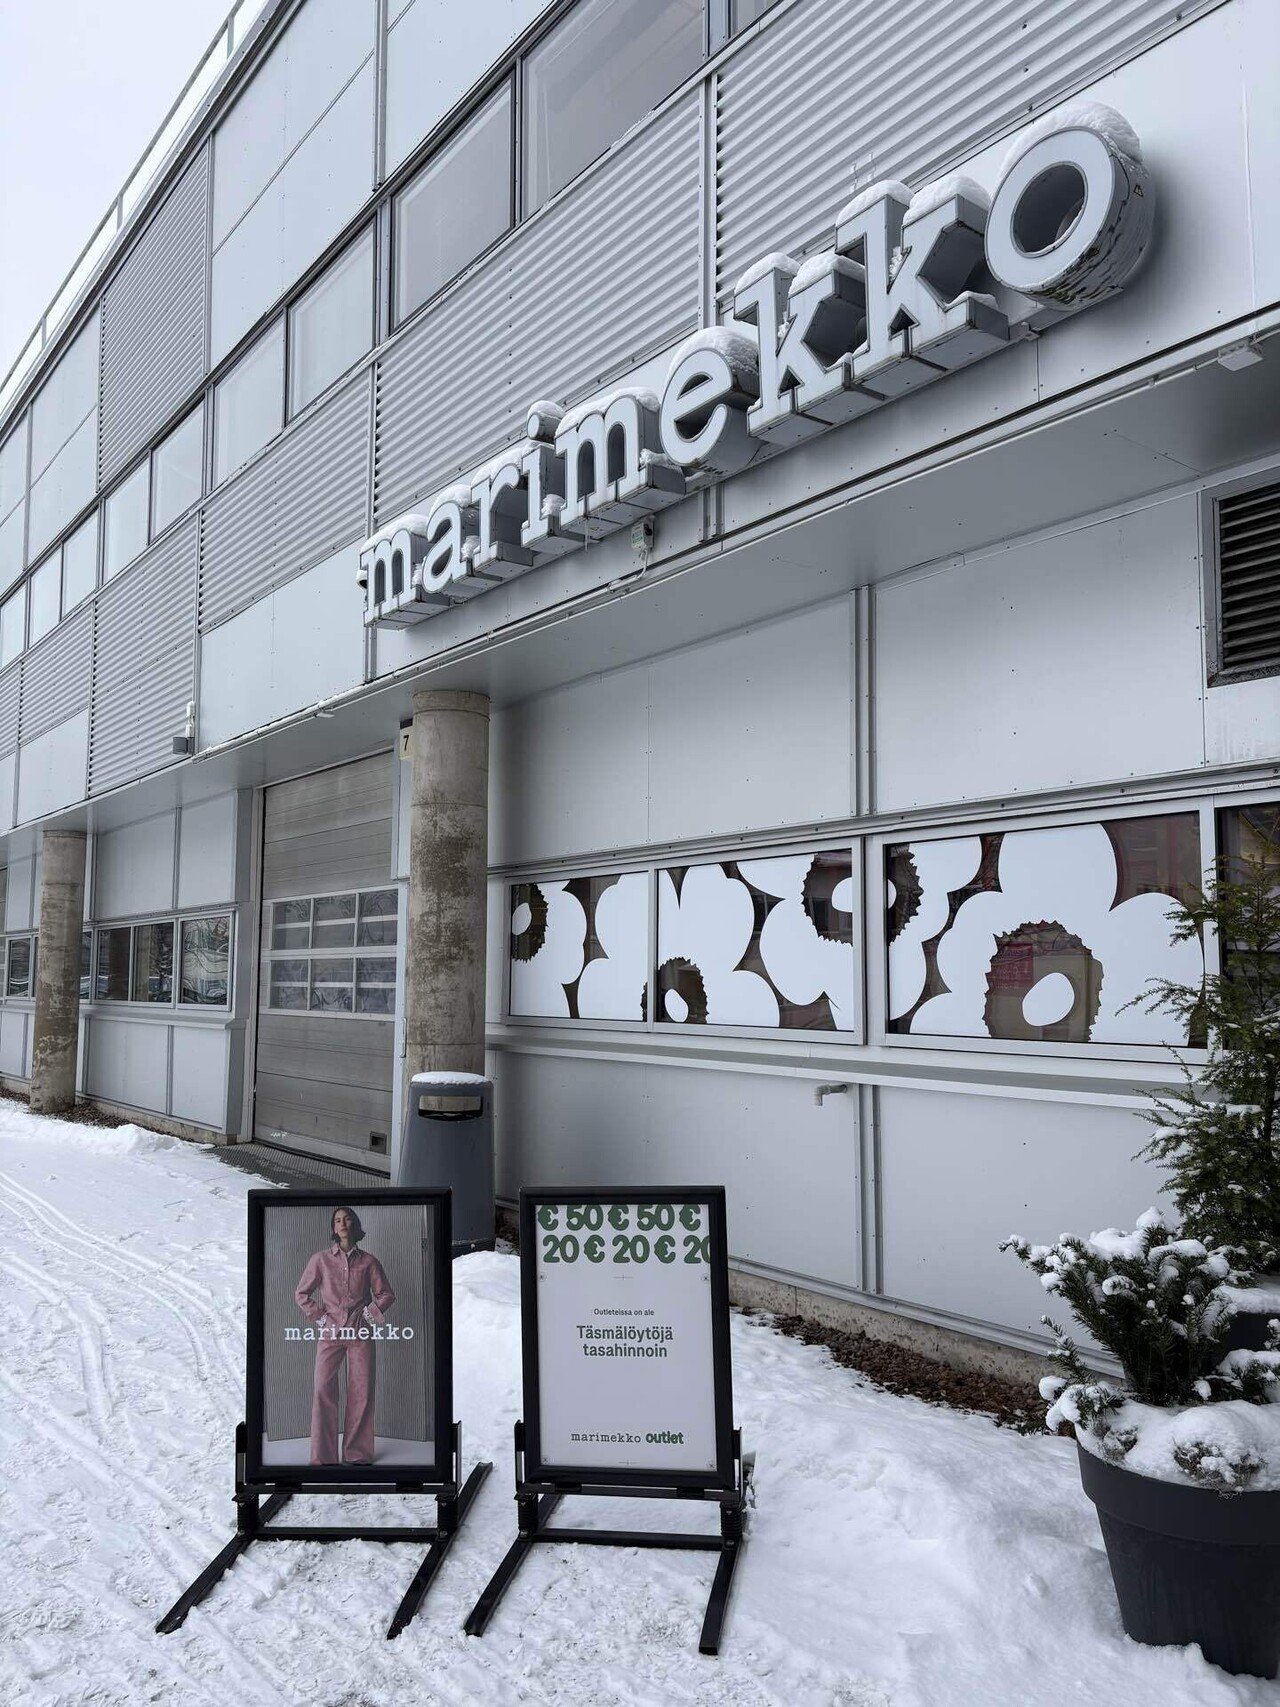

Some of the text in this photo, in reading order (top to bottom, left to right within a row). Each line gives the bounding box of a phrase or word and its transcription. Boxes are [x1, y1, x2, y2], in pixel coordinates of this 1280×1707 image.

[360, 114, 1140, 625] marimekko
[403, 734, 410, 751] 7
[644, 1308, 655, 1316] ale
[284, 1323, 414, 1340] marimekko
[576, 1325, 673, 1343] Täsmälöytöjä
[583, 1343, 667, 1357] tasahinnoin
[571, 1431, 684, 1444] marimekko outlet
